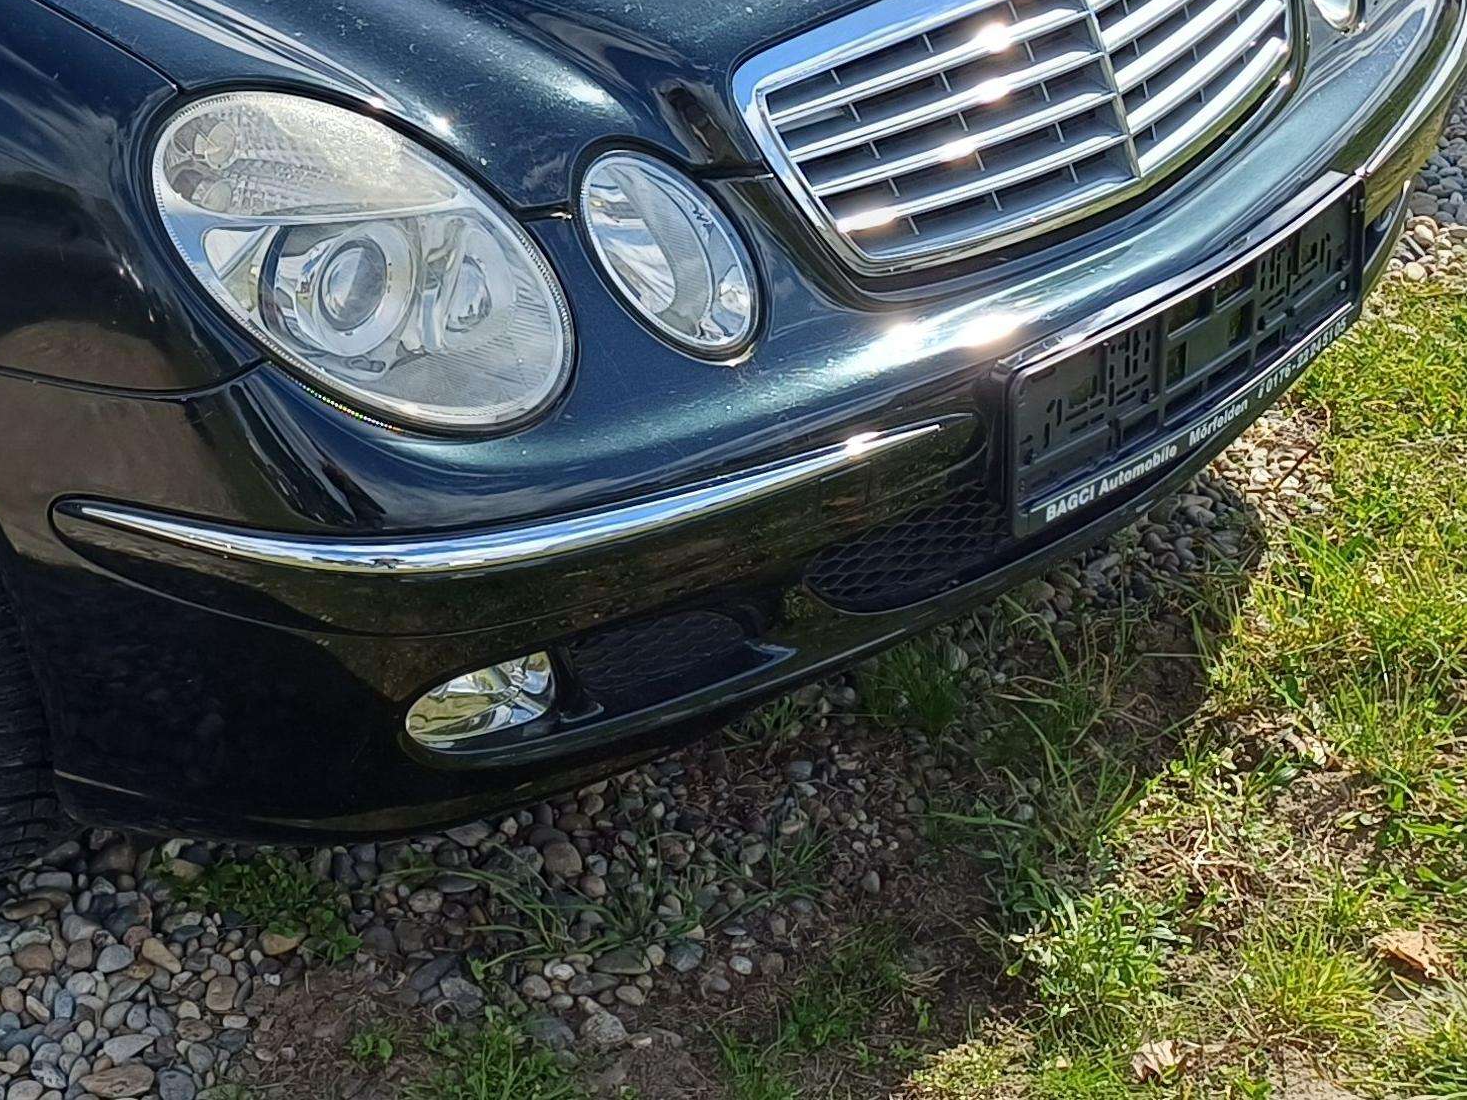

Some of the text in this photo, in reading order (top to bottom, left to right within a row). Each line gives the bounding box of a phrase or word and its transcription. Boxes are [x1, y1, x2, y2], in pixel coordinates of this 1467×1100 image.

[1045, 487, 1095, 522] BAGCI
[1098, 444, 1178, 496] Automobile
[1188, 399, 1248, 447] Mörfelden
